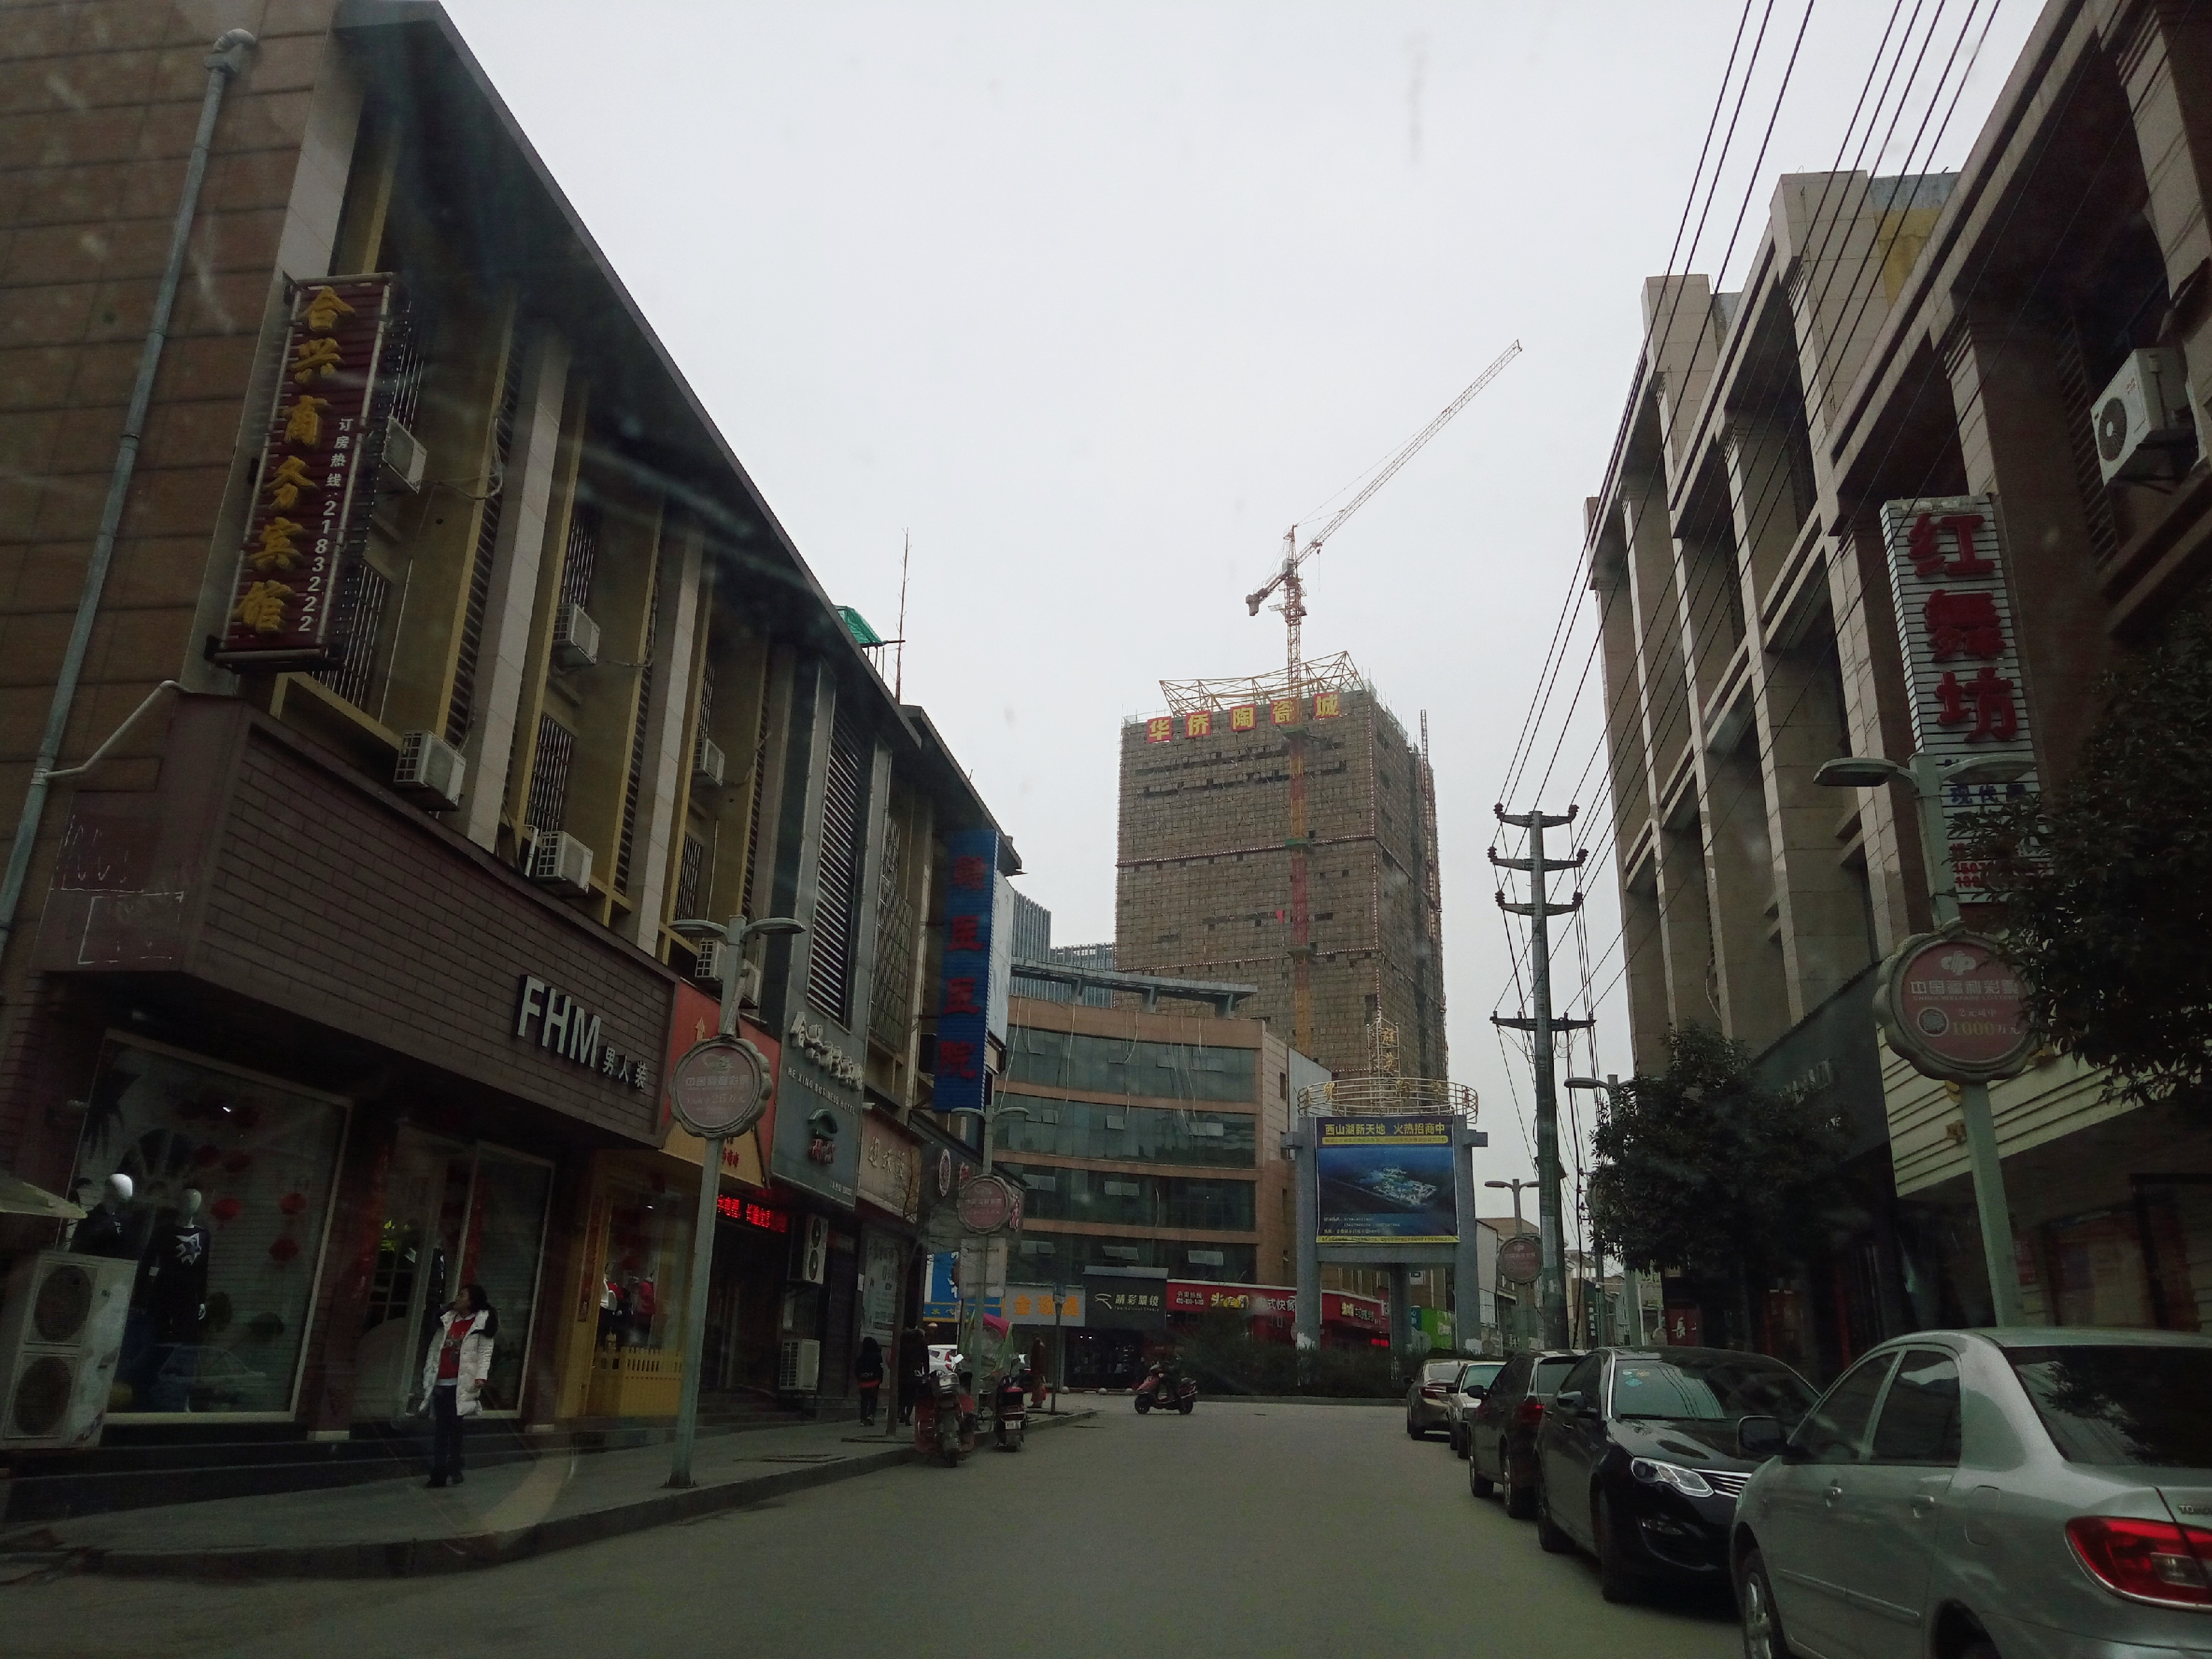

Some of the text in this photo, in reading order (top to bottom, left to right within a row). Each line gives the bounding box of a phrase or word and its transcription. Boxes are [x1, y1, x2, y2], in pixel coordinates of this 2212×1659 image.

[232, 285, 356, 634] 合兴商务宾馆
[1907, 512, 2018, 743] 红舞坊
[1148, 693, 1339, 741] 华侨陶瓷城
[1910, 980, 2019, 994] 中国福利彩票
[516, 975, 602, 1069] FHM
[602, 1046, 647, 1090] 男人装
[1325, 1122, 1445, 1135] 西山湖新天地 火热招商中
[1115, 1294, 1160, 1307] 睛彩眼镜
